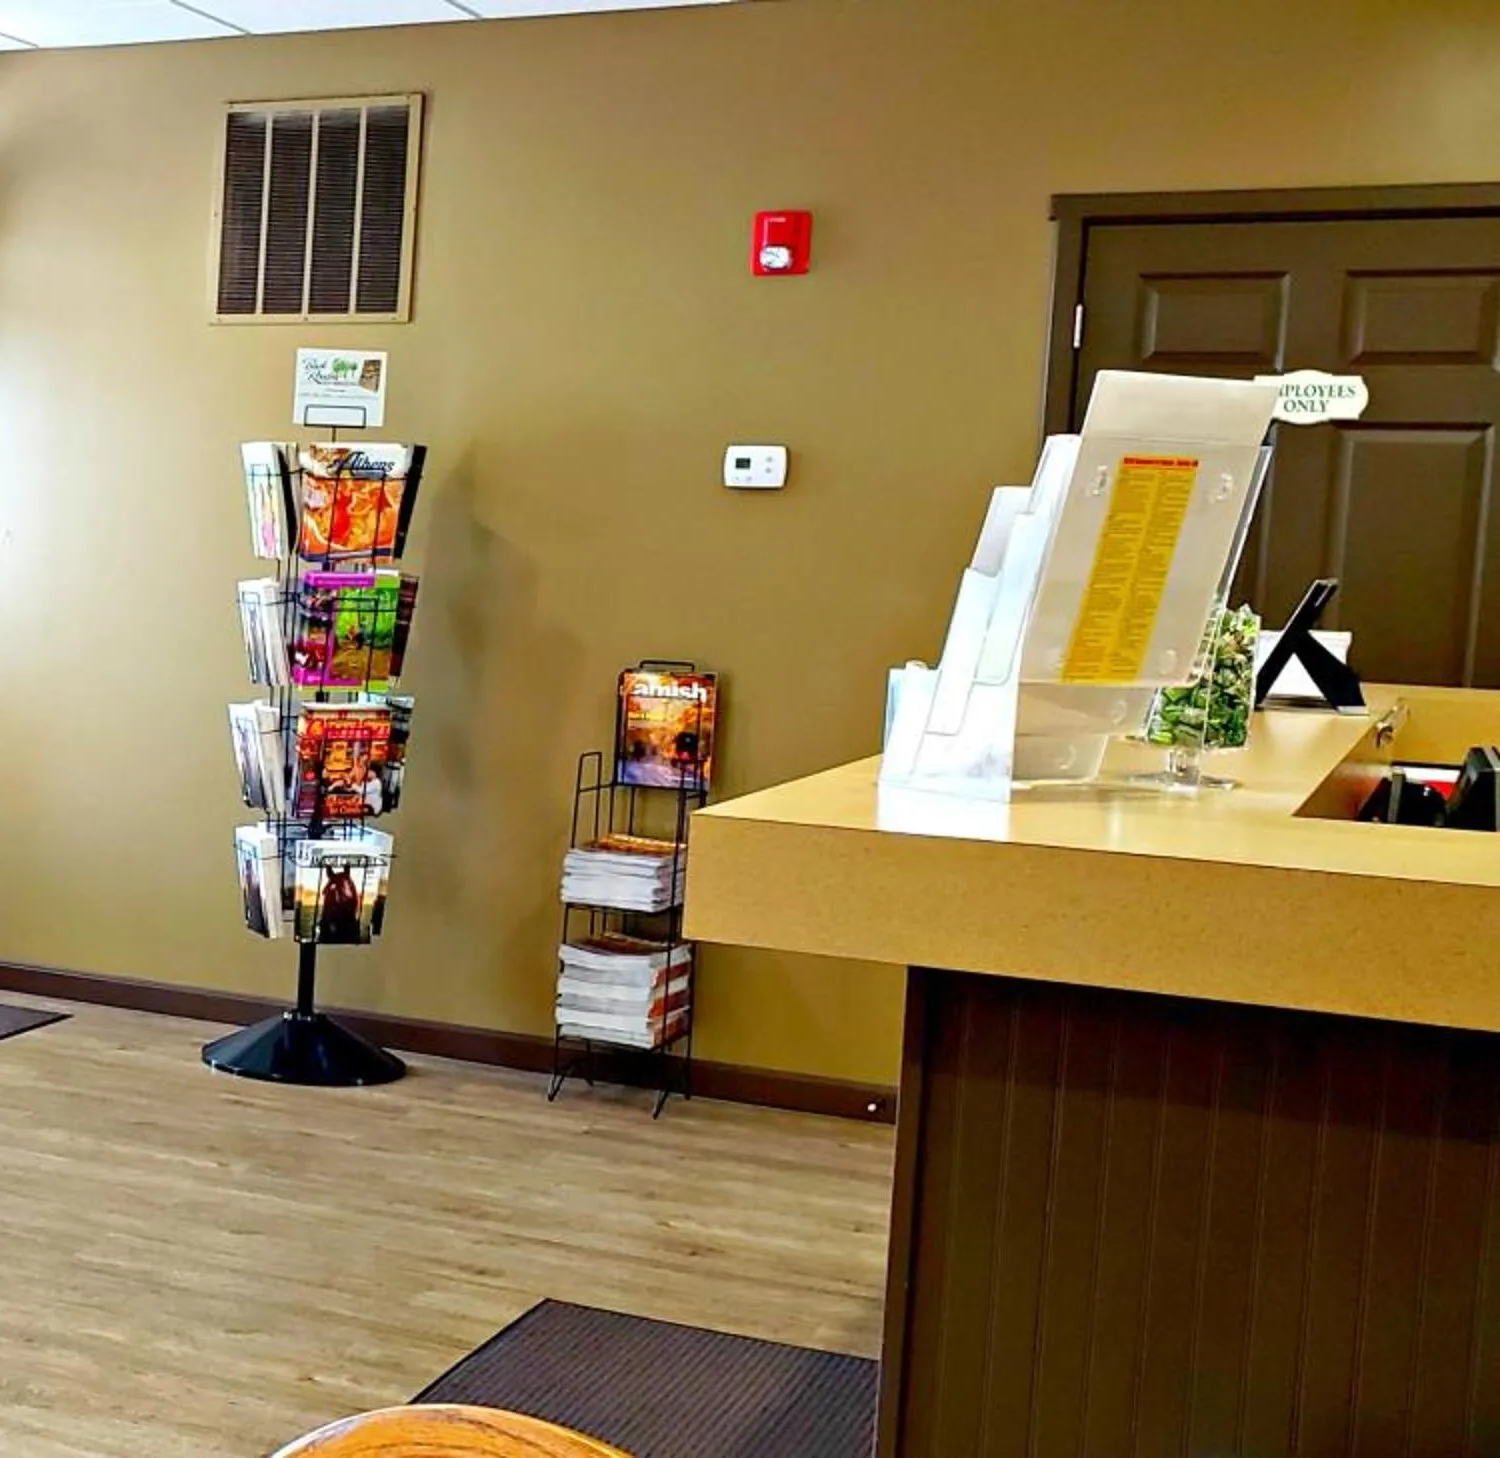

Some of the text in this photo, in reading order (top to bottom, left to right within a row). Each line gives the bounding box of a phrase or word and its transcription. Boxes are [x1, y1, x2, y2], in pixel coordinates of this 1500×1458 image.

[1278, 383, 1357, 398] PLOYEES
[1283, 399, 1330, 413] ONLY
[630, 680, 708, 702] amish
